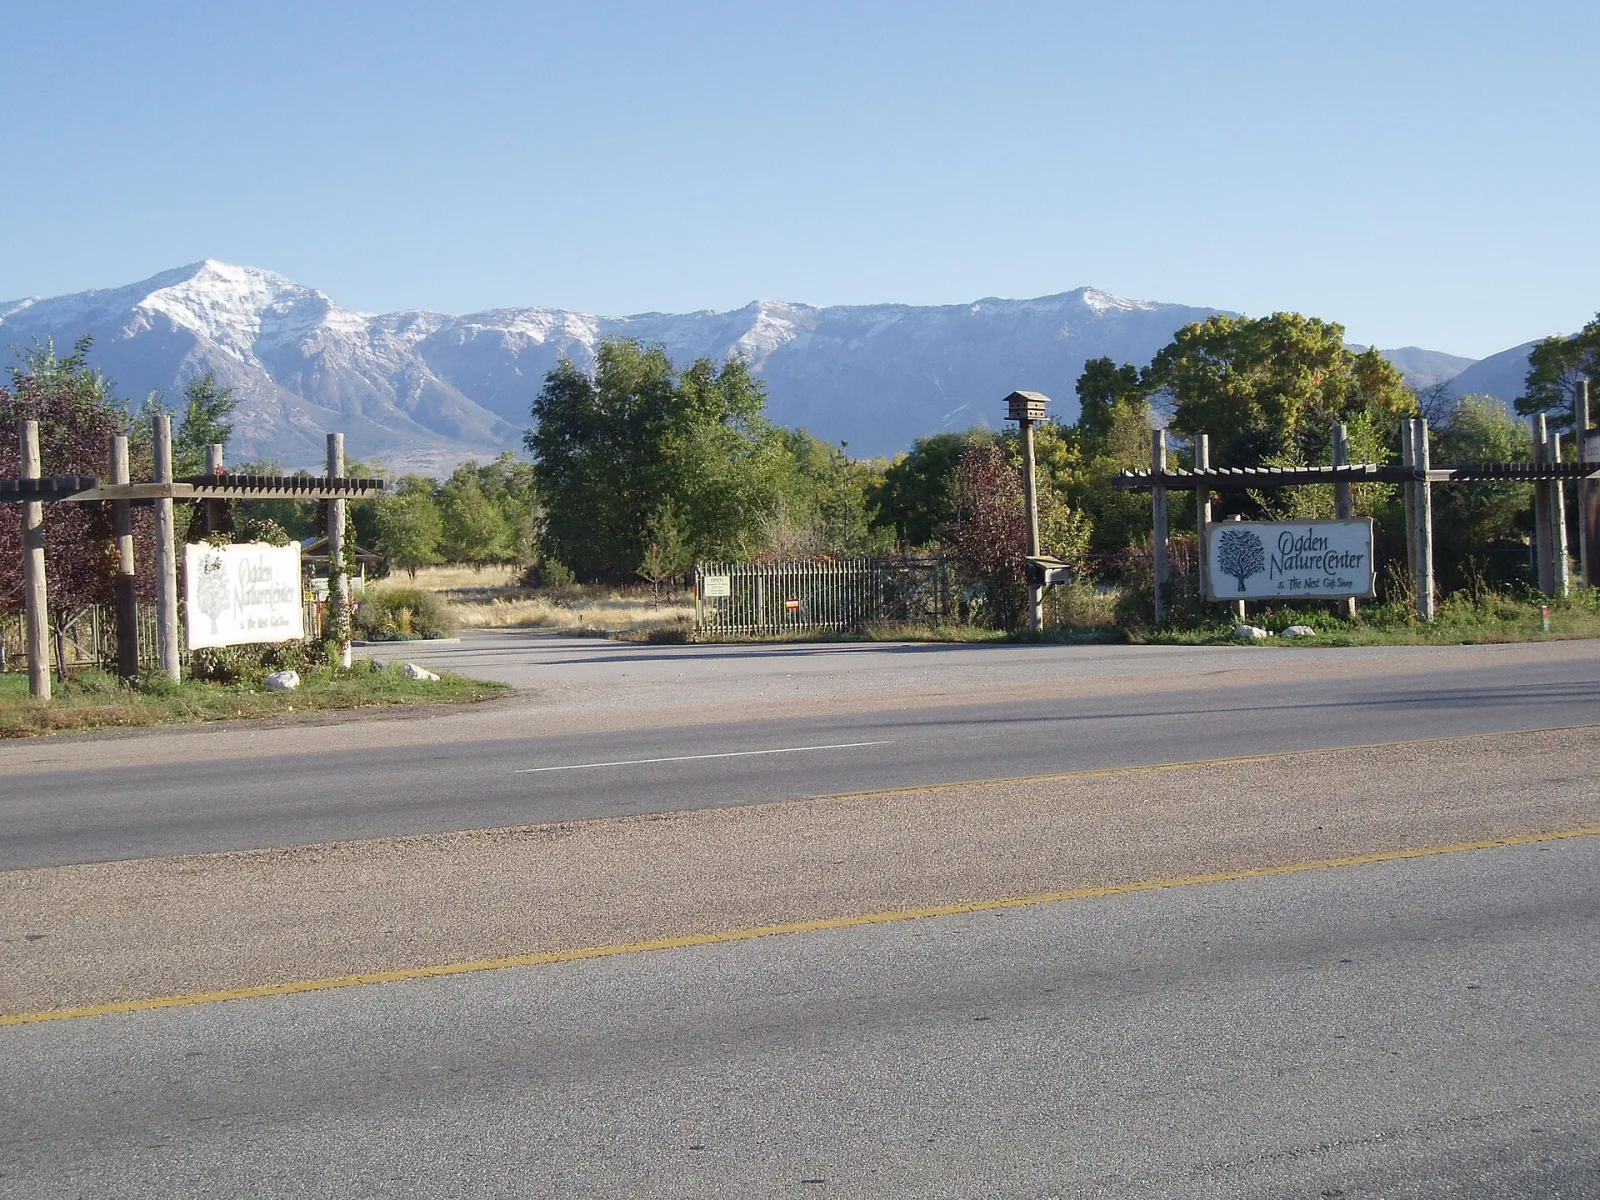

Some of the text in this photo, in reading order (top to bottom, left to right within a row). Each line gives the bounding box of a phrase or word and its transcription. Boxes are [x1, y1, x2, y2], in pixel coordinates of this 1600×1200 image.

[1278, 527, 1328, 556] Ogden
[1288, 576, 1301, 590] The
[1304, 577, 1320, 588] Nest
